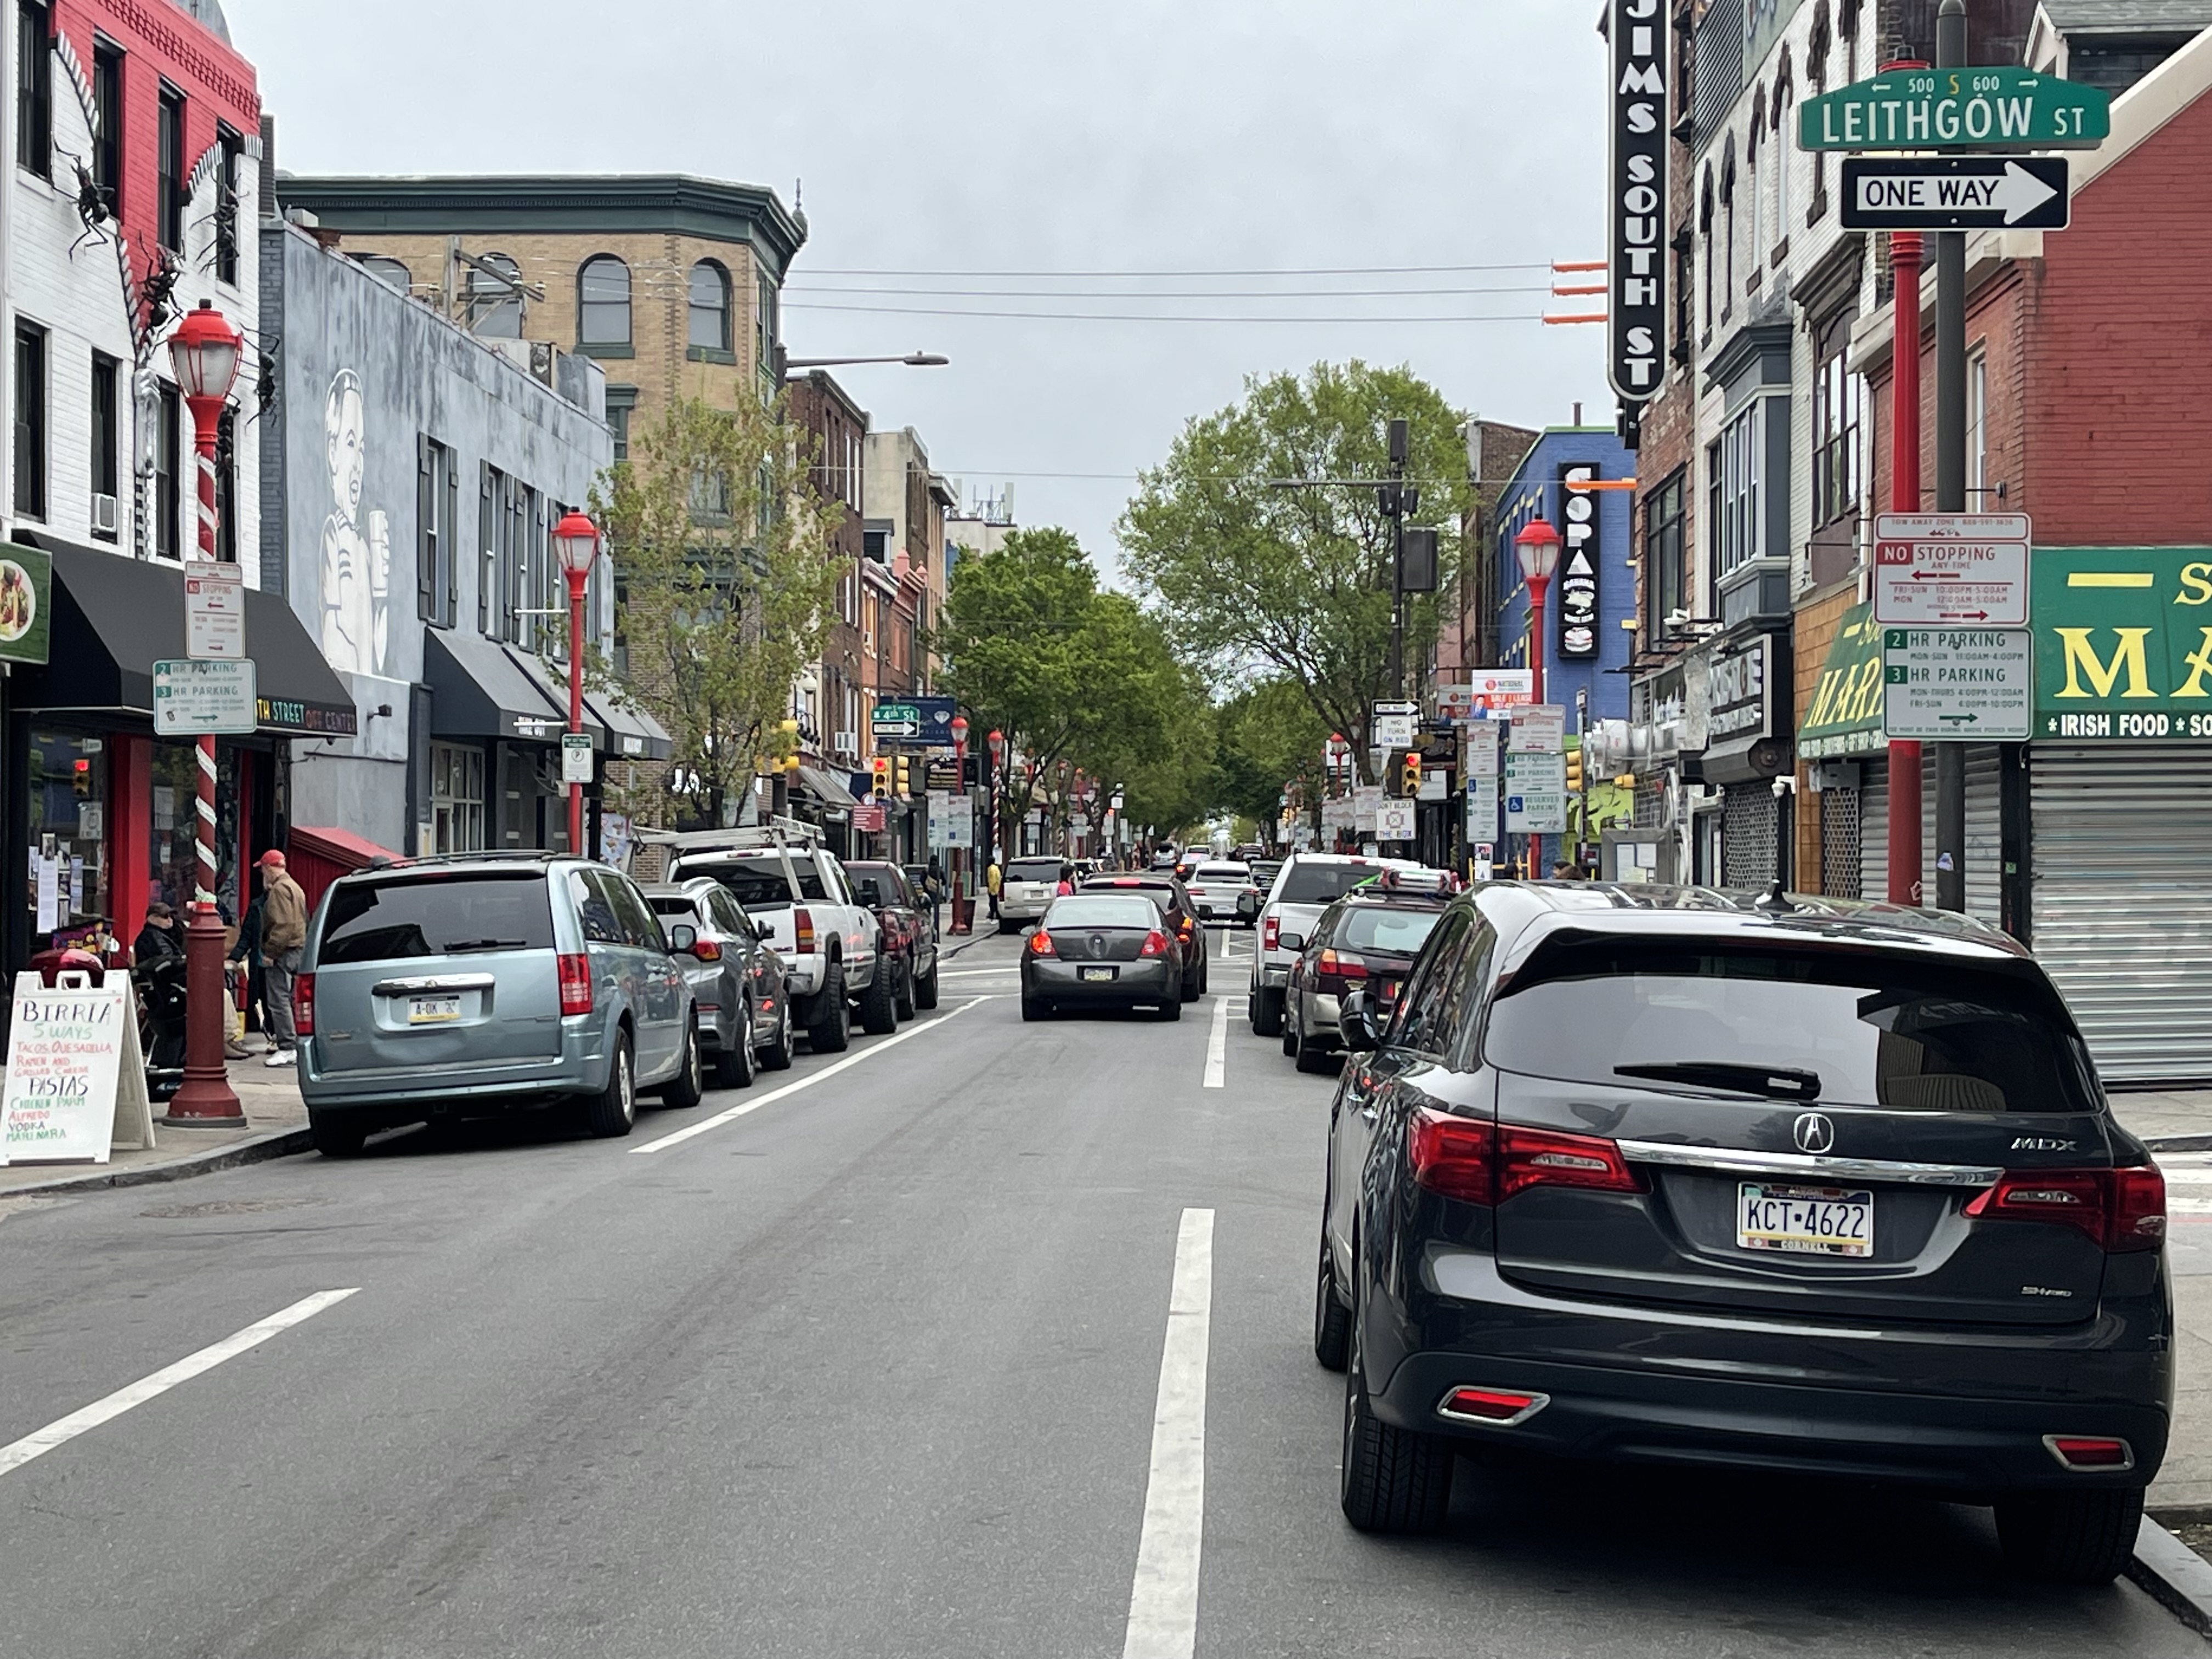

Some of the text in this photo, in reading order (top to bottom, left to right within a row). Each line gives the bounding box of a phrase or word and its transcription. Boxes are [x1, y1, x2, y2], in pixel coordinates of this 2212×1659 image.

[1908, 74, 2000, 95] 500 S 600
[1823, 96, 2085, 143] LEITHGOW ST
[1866, 179, 2000, 206] ONE WAY
[1624, 154, 1658, 306] SOUTH
[1623, 327, 1657, 386] ST
[1884, 546, 1995, 561] NO STOPPING
[1892, 633, 2006, 647] 2 HR PARKING
[172, 665, 187, 673] HR
[191, 663, 238, 673] PARKING
[1892, 667, 2006, 682] 3 HR PARKING
[173, 687, 187, 696] HR
[193, 686, 238, 696] PARKING
[256, 698, 270, 720] TH
[273, 701, 305, 724] STREET
[2061, 714, 2111, 737] IRISH
[2119, 713, 2169, 737] FOOD
[23, 1000, 112, 1025] BIRRIA
[32, 1023, 93, 1040] 5 WAYS
[17, 1041, 49, 1054] TACOS
[52, 1057, 70, 1066] AND
[29, 1075, 89, 1096] PASTAS
[8, 1110, 50, 1122] ALFREDO
[8, 1121, 46, 1132] VODKA
[6, 1128, 67, 1142] MARINARA
[2011, 1137, 2078, 1152] MDX
[1781, 1237, 1831, 1252] CORNELL
